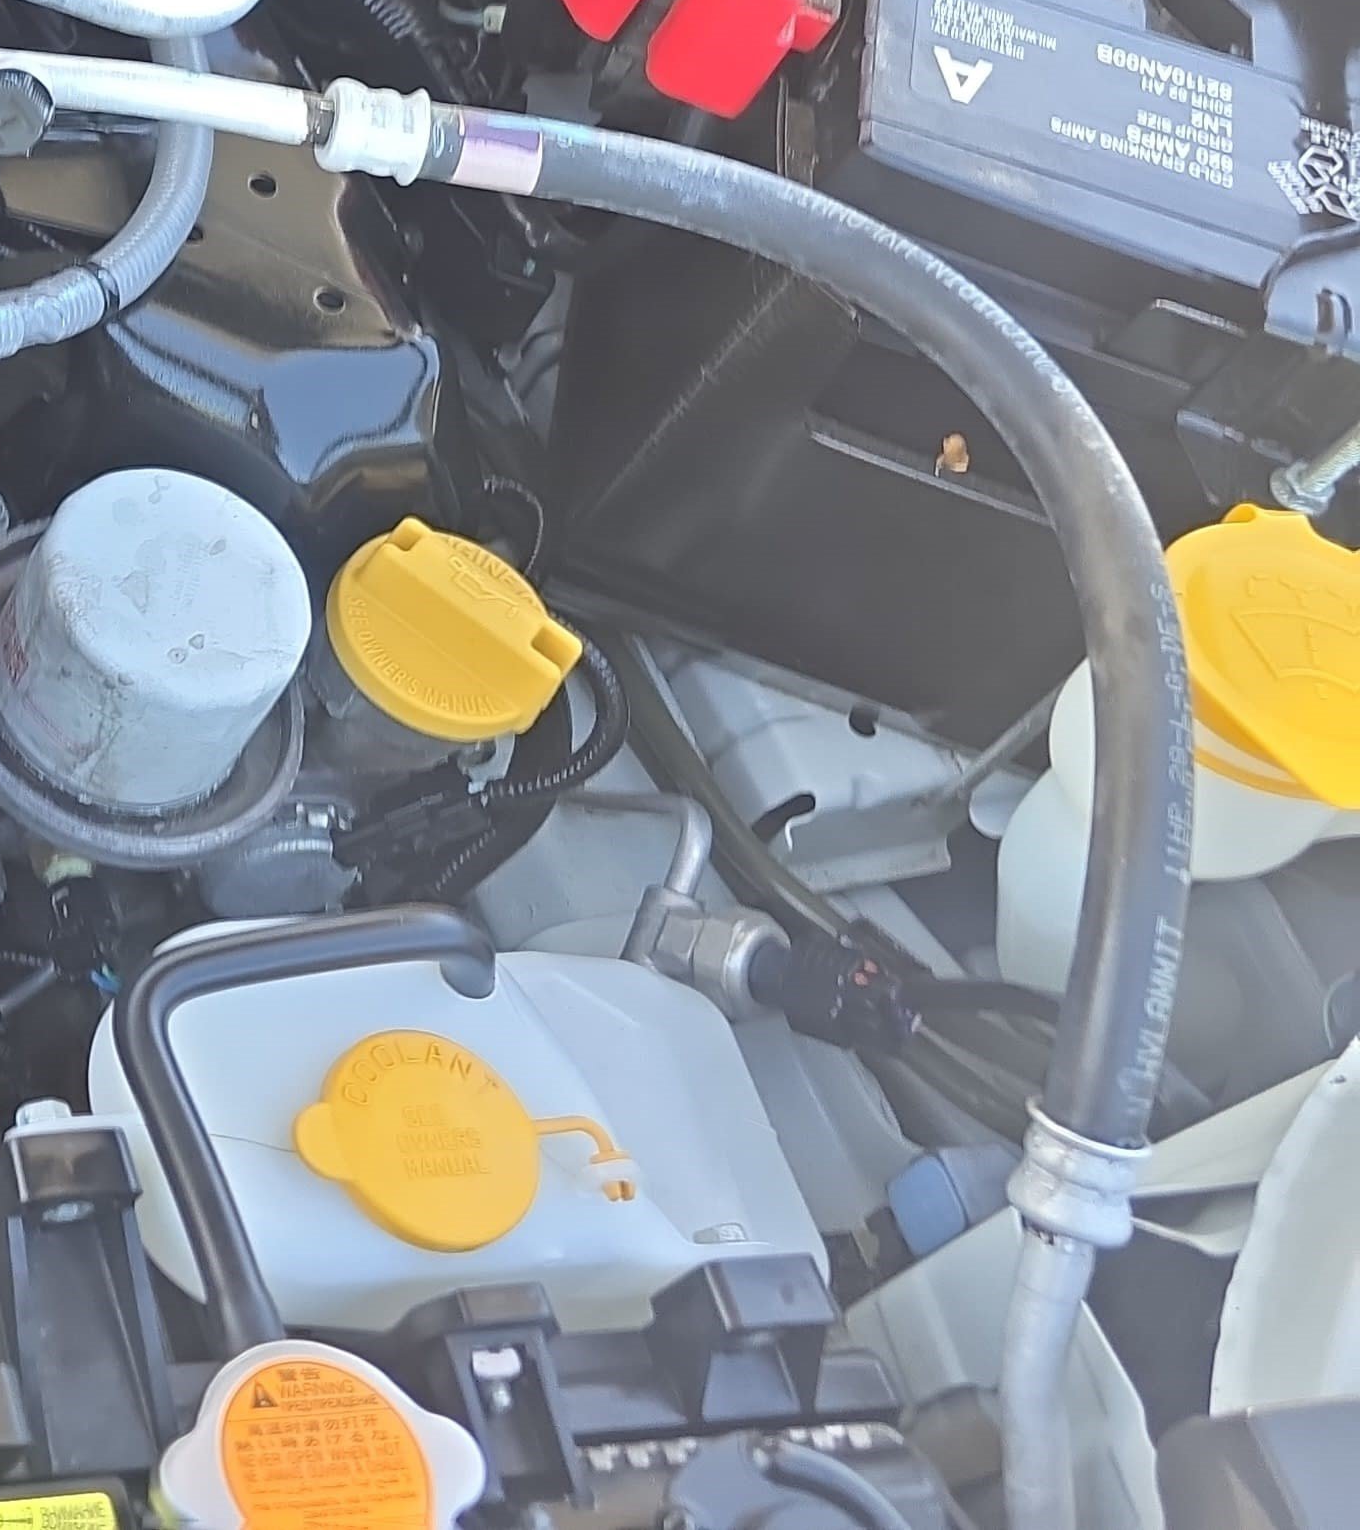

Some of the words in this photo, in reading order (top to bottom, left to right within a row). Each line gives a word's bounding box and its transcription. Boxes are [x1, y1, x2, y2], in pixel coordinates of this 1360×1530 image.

[358, 630, 420, 695] OWNER'S
[423, 686, 499, 717] MANUAL
[342, 1040, 499, 1106] COOLANT
[279, 1379, 354, 1400] WARNING
